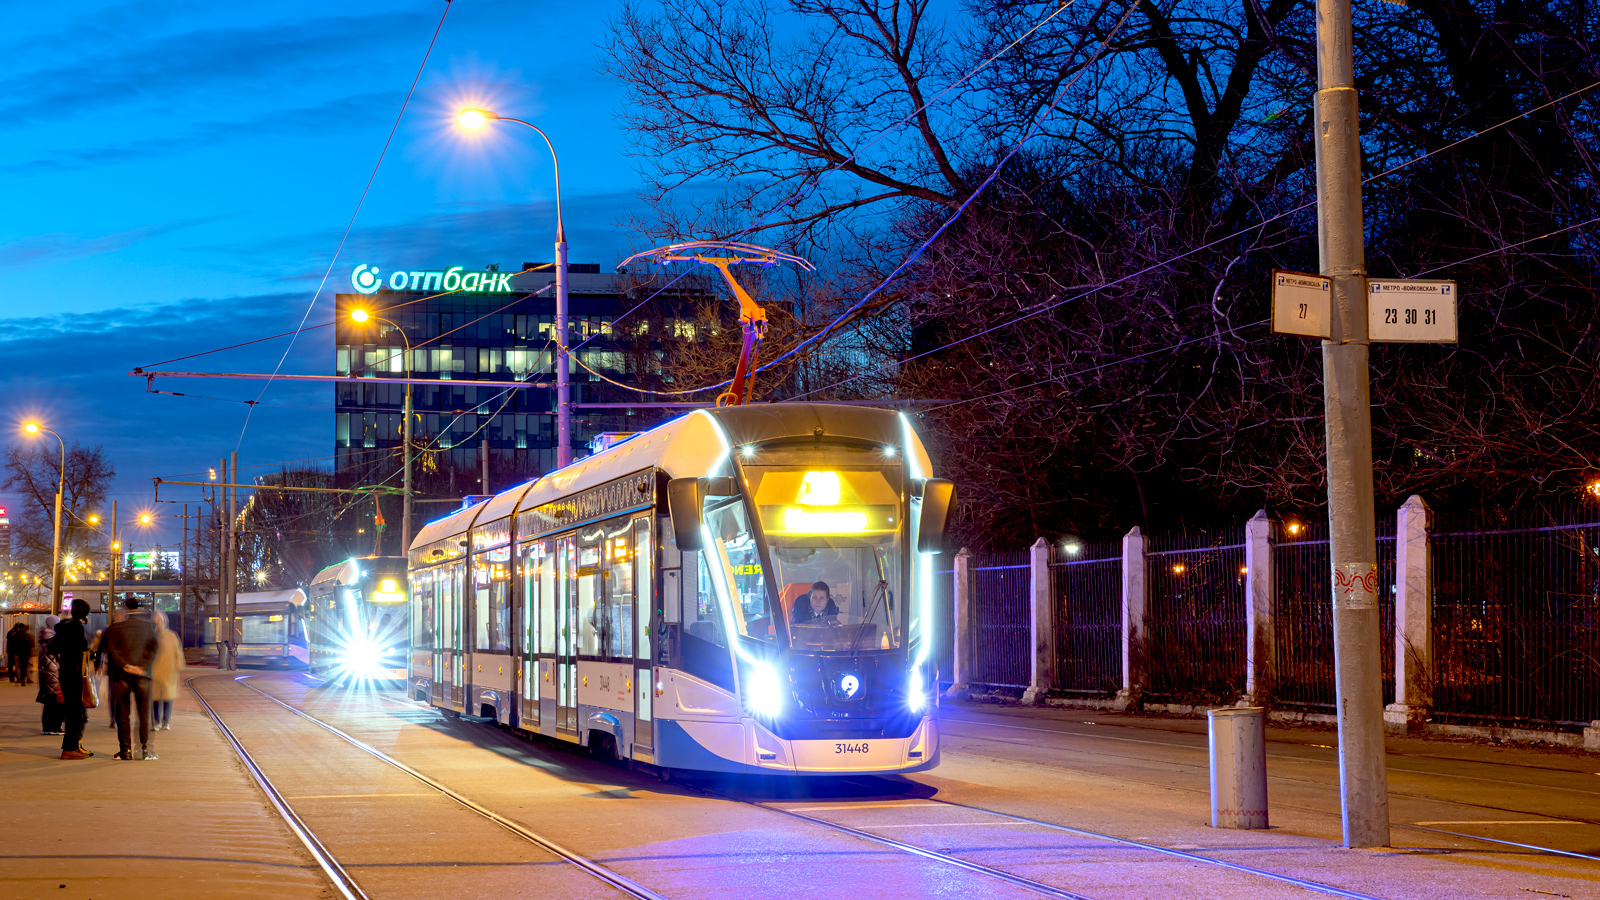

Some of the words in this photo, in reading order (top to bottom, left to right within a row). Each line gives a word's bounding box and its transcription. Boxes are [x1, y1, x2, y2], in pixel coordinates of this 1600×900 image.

[1299, 303, 1308, 319] 27
[1385, 308, 1397, 324] 23
[1405, 308, 1417, 324] 30
[1425, 309, 1436, 325] 31
[835, 743, 869, 754] 31448
